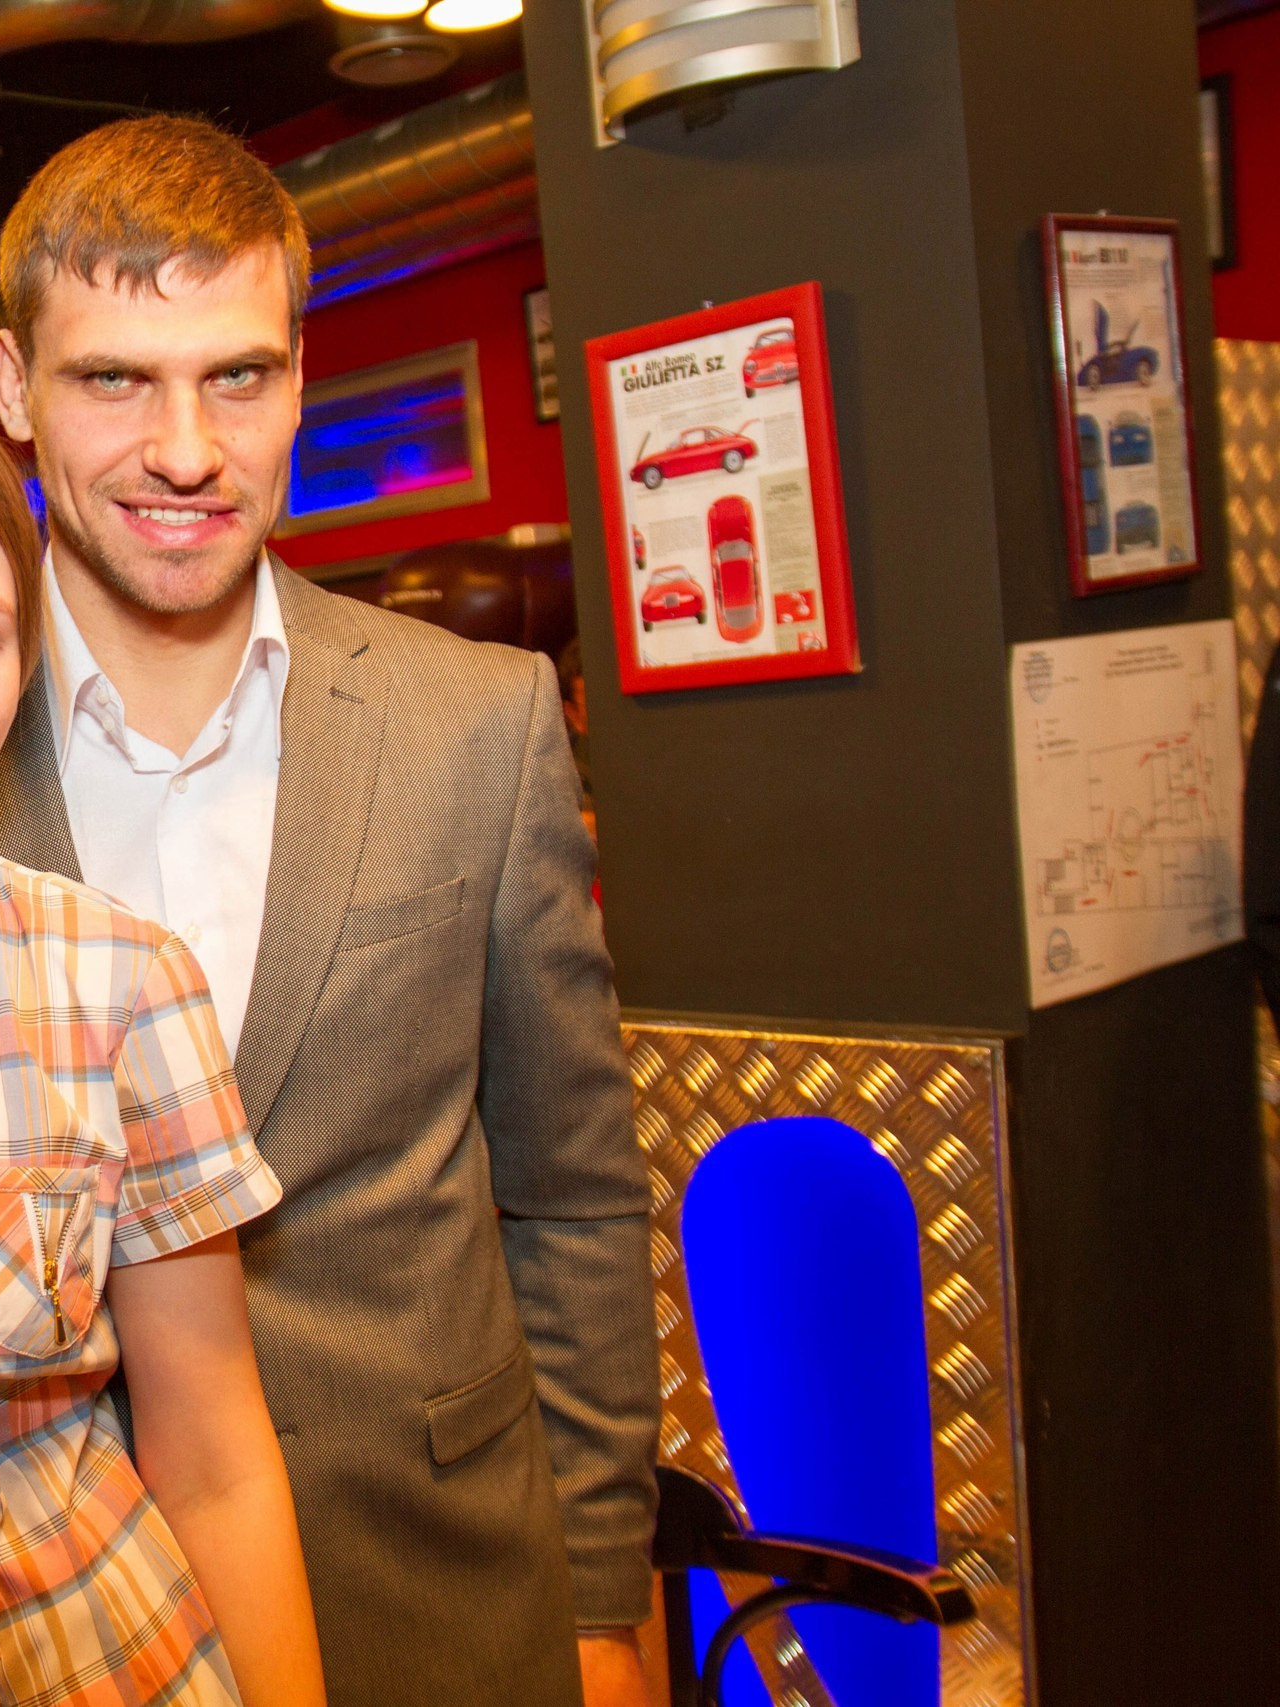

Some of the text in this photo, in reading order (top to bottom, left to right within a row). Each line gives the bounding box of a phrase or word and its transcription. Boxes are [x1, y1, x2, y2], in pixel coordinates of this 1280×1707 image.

[624, 354, 726, 392] GIULIETTA SZ
[664, 352, 696, 369] Romeo
